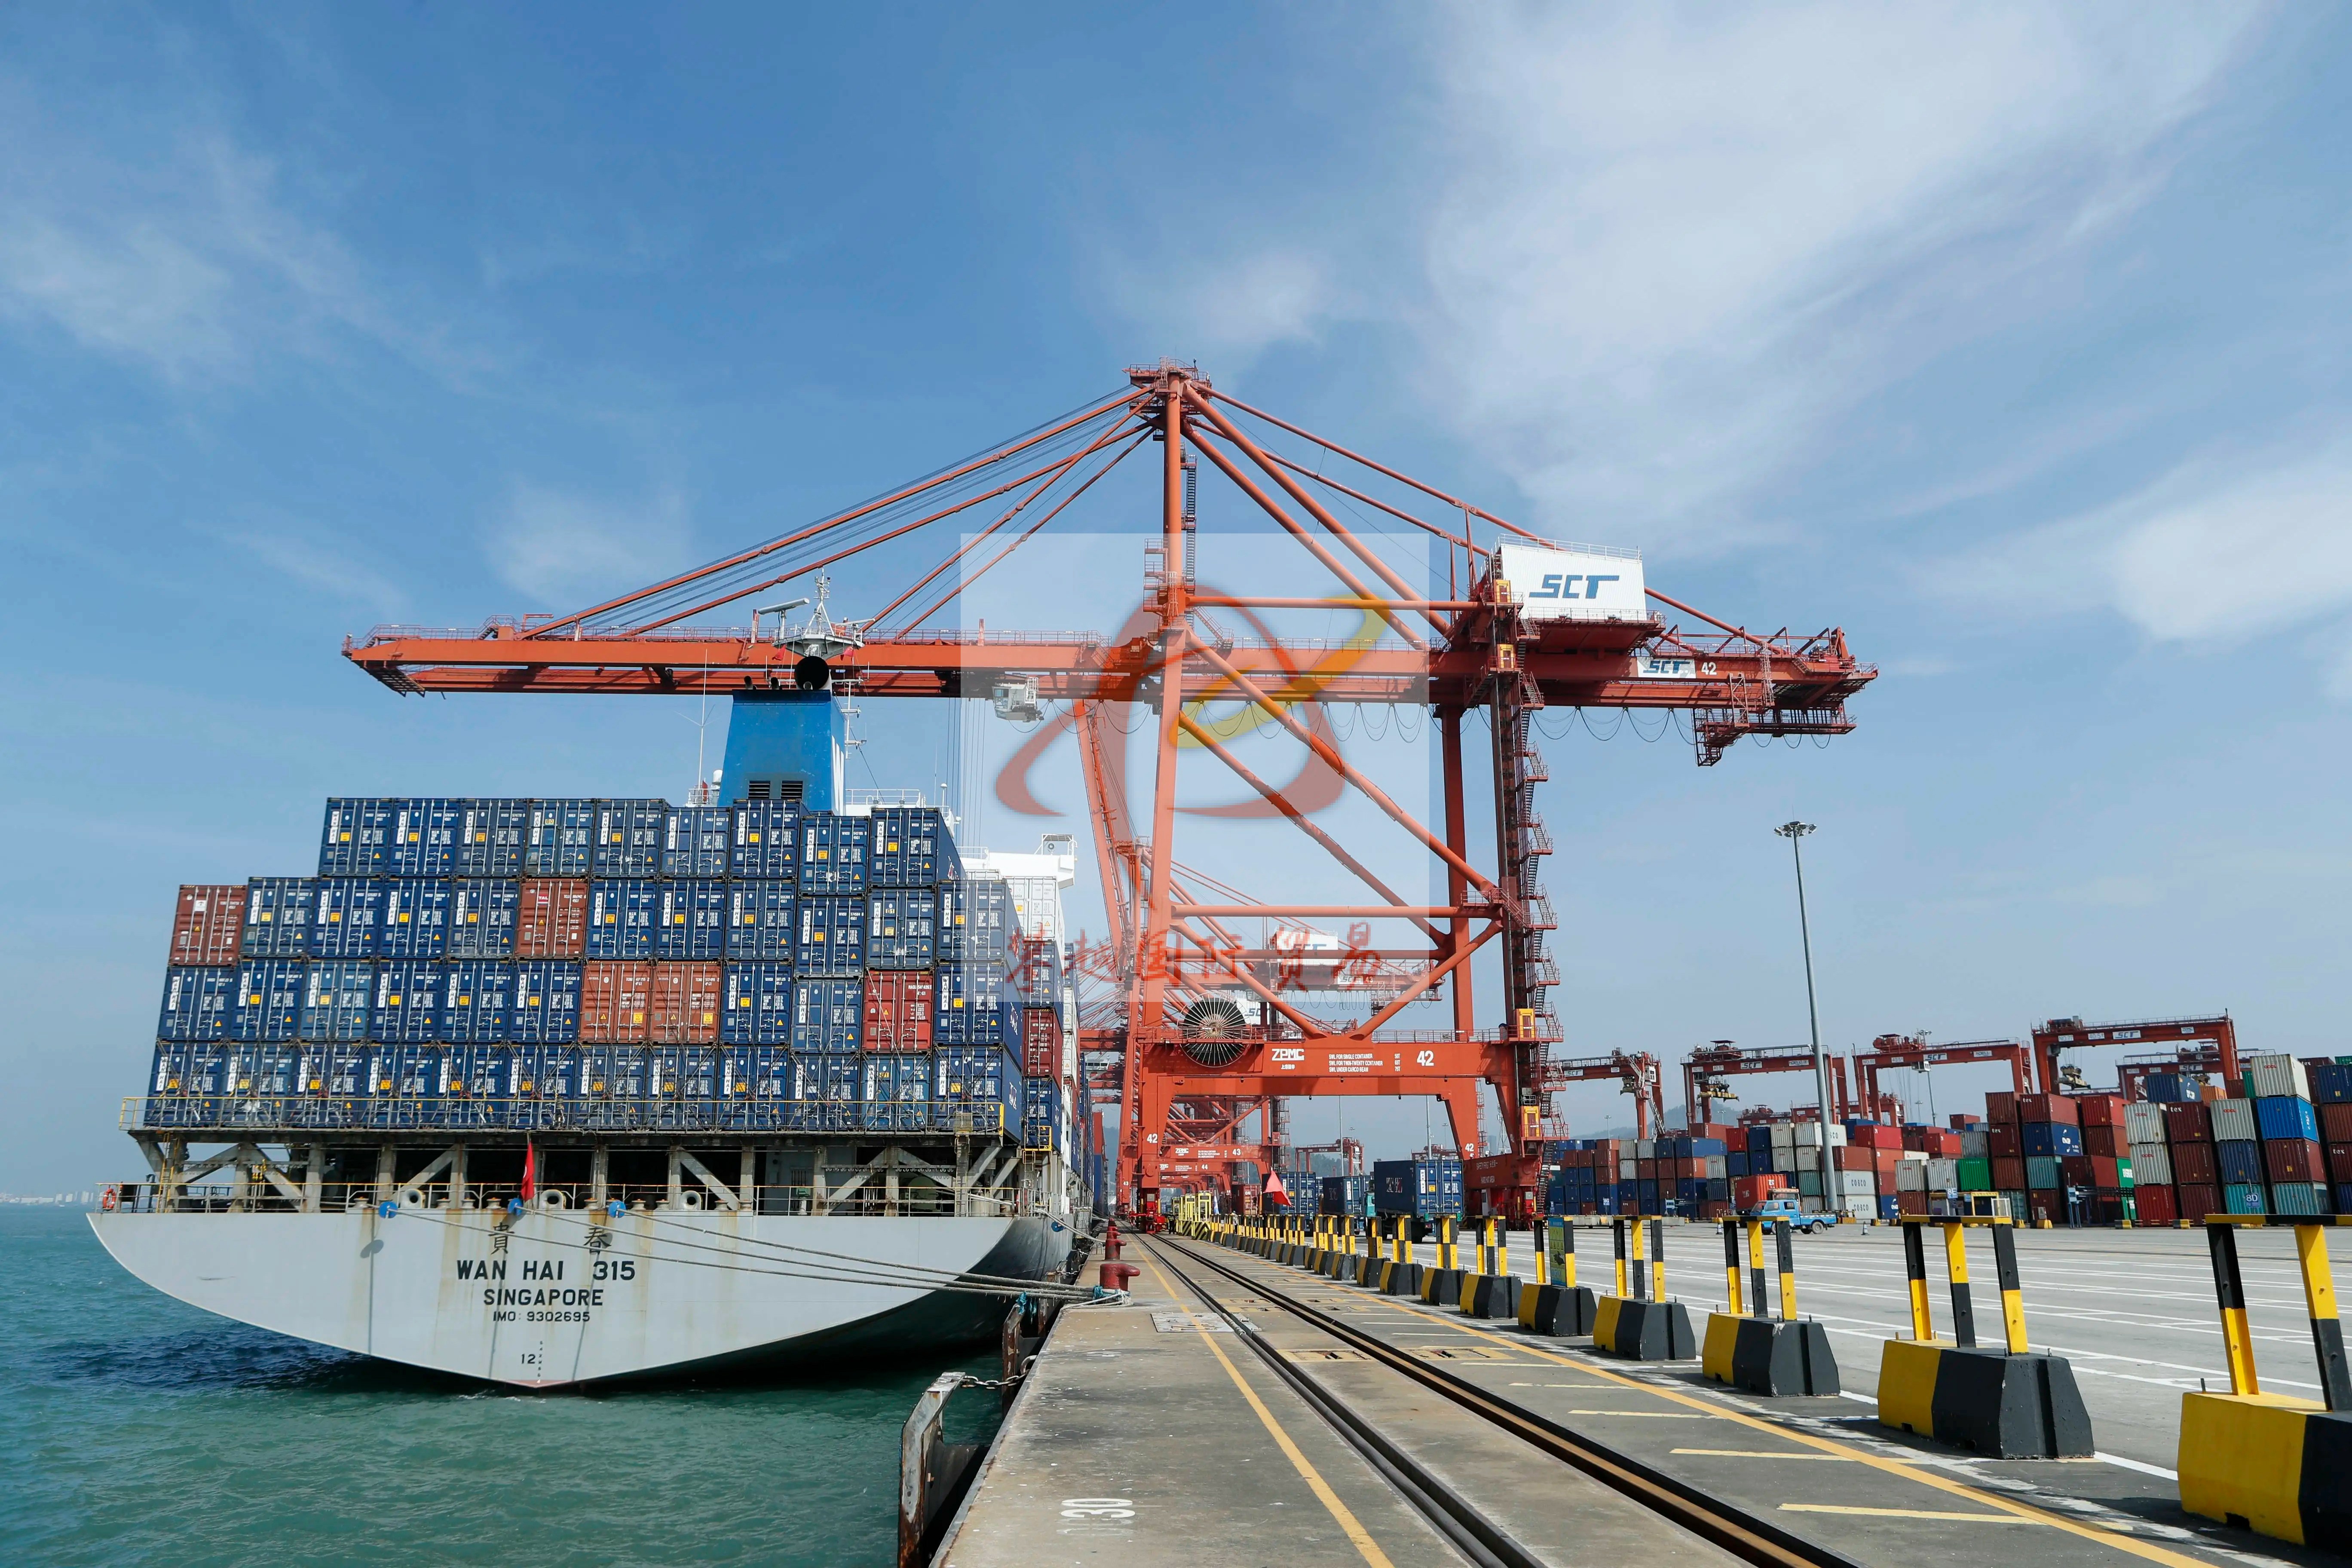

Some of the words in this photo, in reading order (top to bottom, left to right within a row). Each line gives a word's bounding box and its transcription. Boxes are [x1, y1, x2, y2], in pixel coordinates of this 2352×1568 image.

[1529, 575, 1620, 599] SCT
[1643, 661, 1690, 674] SCT
[1701, 662, 1717, 675] 42
[1272, 1048, 1305, 1060] ZPMC
[1417, 1050, 1434, 1066] 42
[1147, 1133, 1158, 1143] 42
[457, 1260, 506, 1280] WAN
[523, 1260, 564, 1280] HAI
[593, 1261, 635, 1280] 315
[484, 1289, 604, 1306] SINGAPORE
[527, 1311, 590, 1322] 9302695
[521, 1354, 536, 1364] 12
